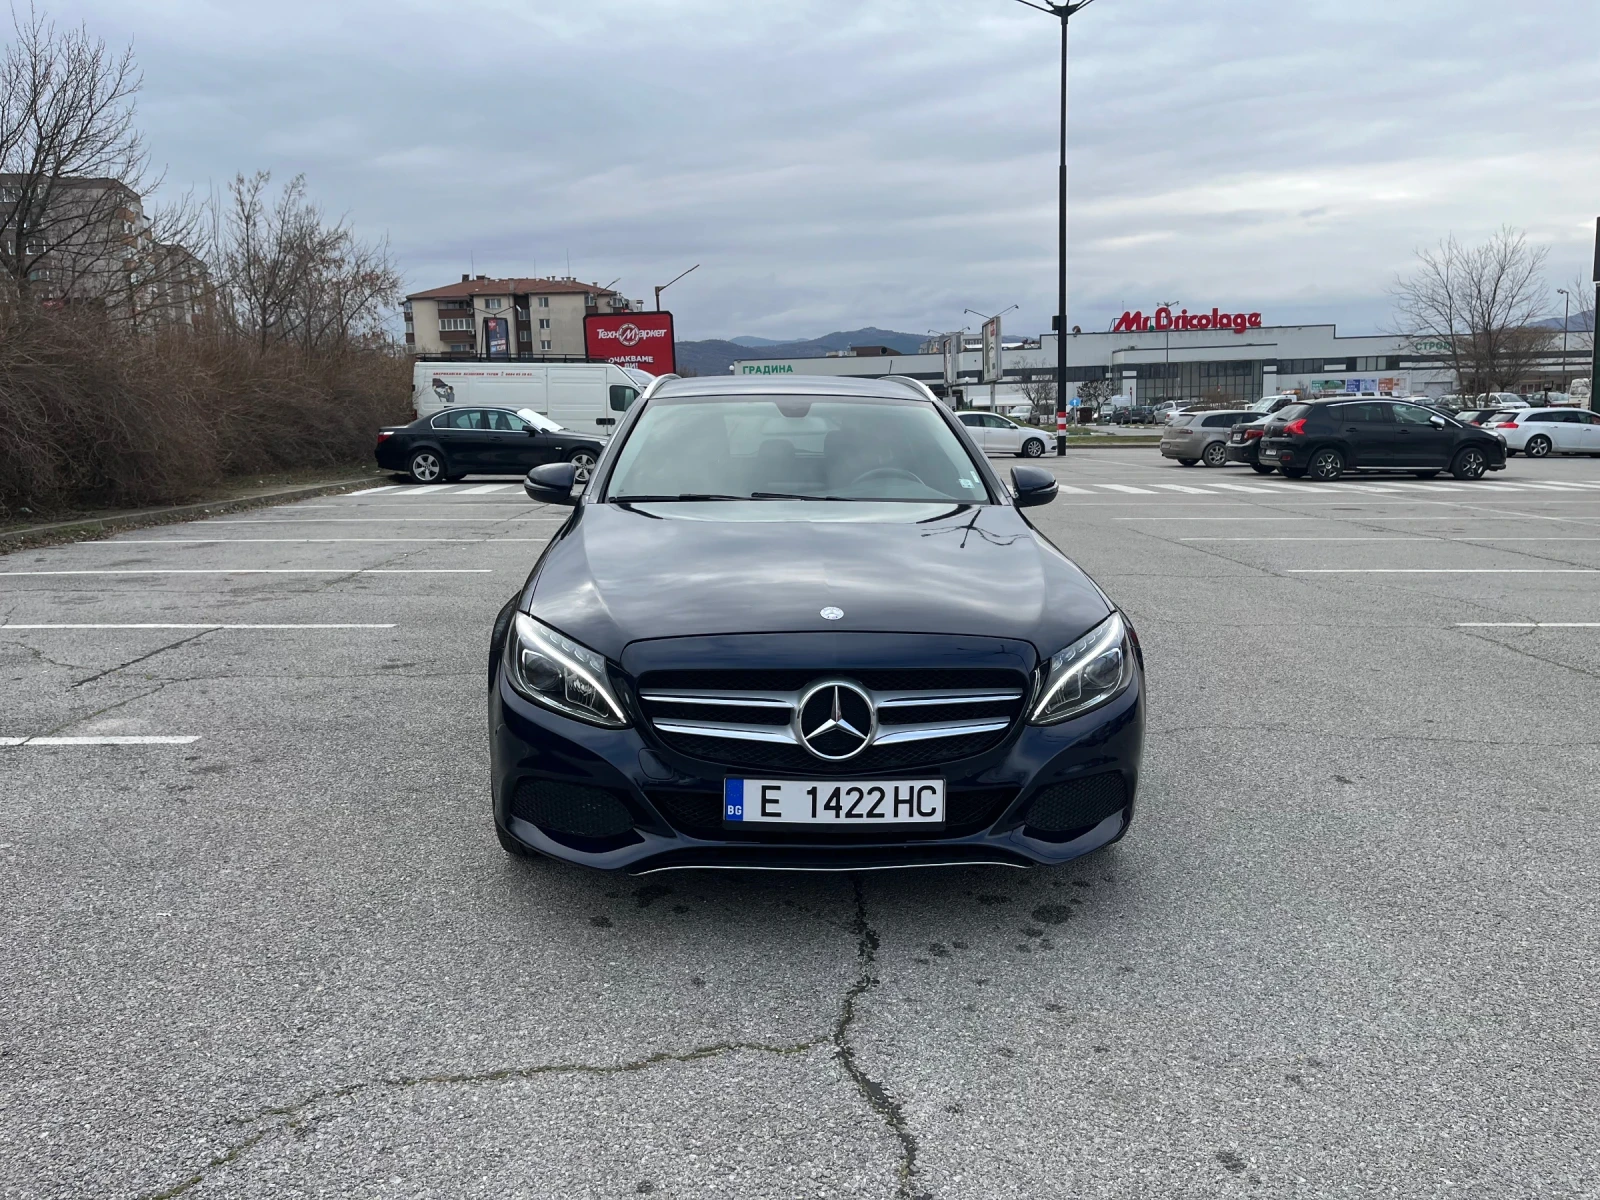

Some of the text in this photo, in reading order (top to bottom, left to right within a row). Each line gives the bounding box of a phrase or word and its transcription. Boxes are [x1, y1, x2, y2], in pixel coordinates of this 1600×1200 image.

[742, 364, 793, 375] ГРАДИНА
[760, 785, 782, 818] E
[727, 804, 742, 816] BG
